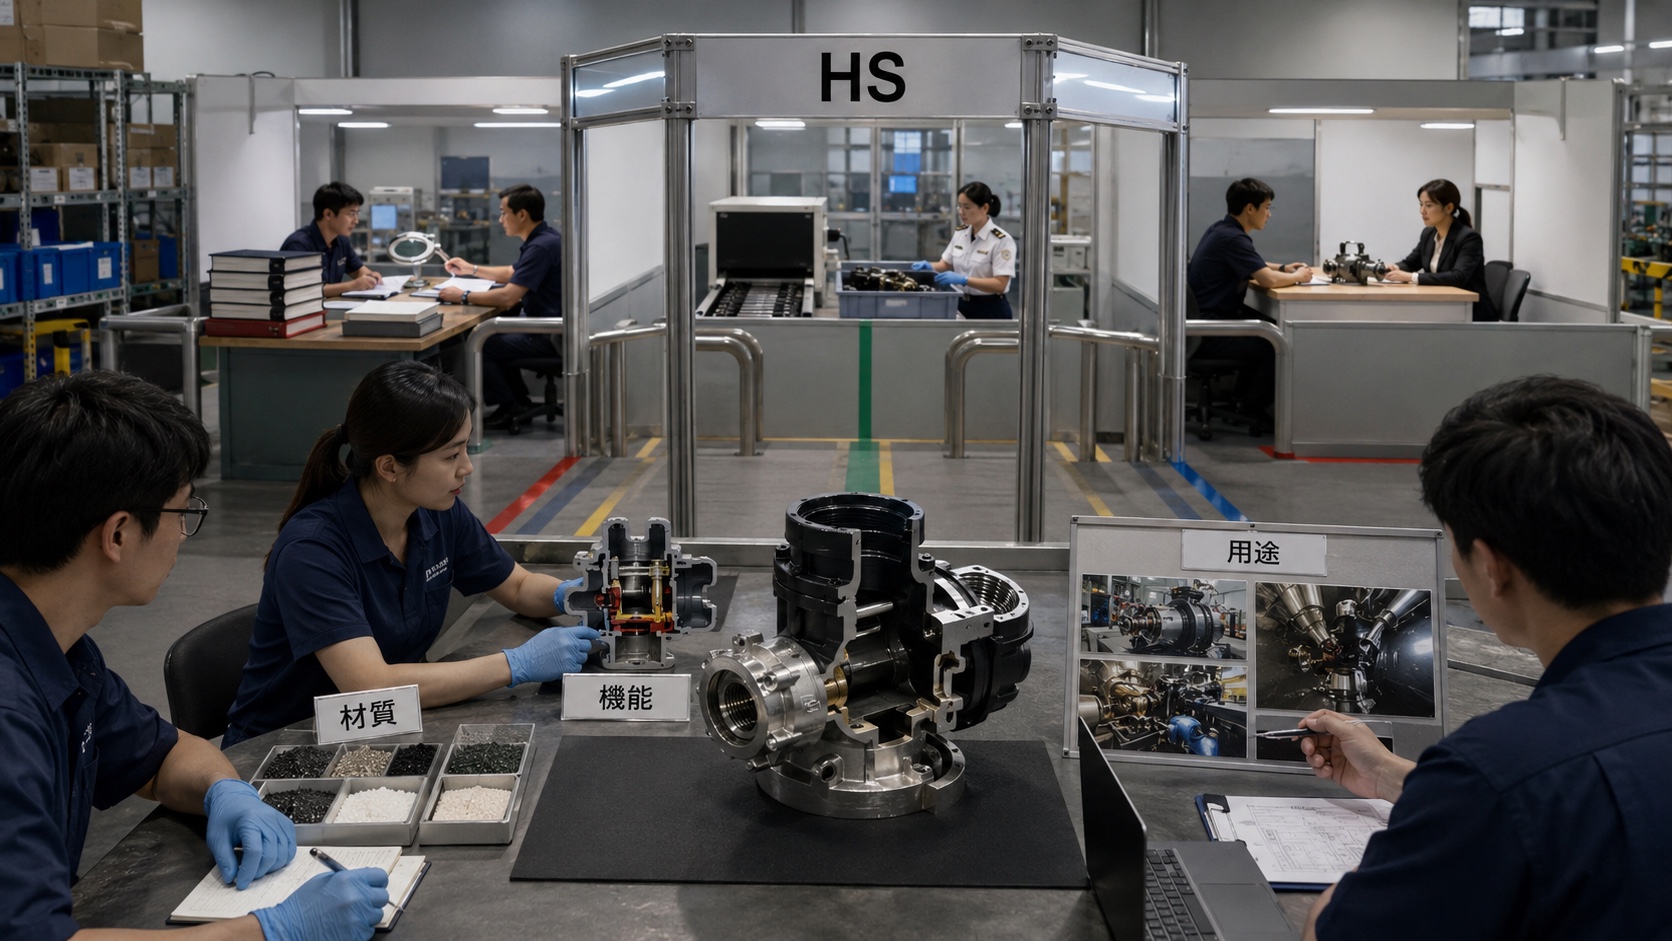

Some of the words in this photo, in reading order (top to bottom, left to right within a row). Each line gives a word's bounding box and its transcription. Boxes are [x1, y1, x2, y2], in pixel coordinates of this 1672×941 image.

[820, 51, 906, 103] HS
[1227, 540, 1280, 566] 用途
[599, 684, 653, 711] 機能
[339, 699, 398, 732] 材質
